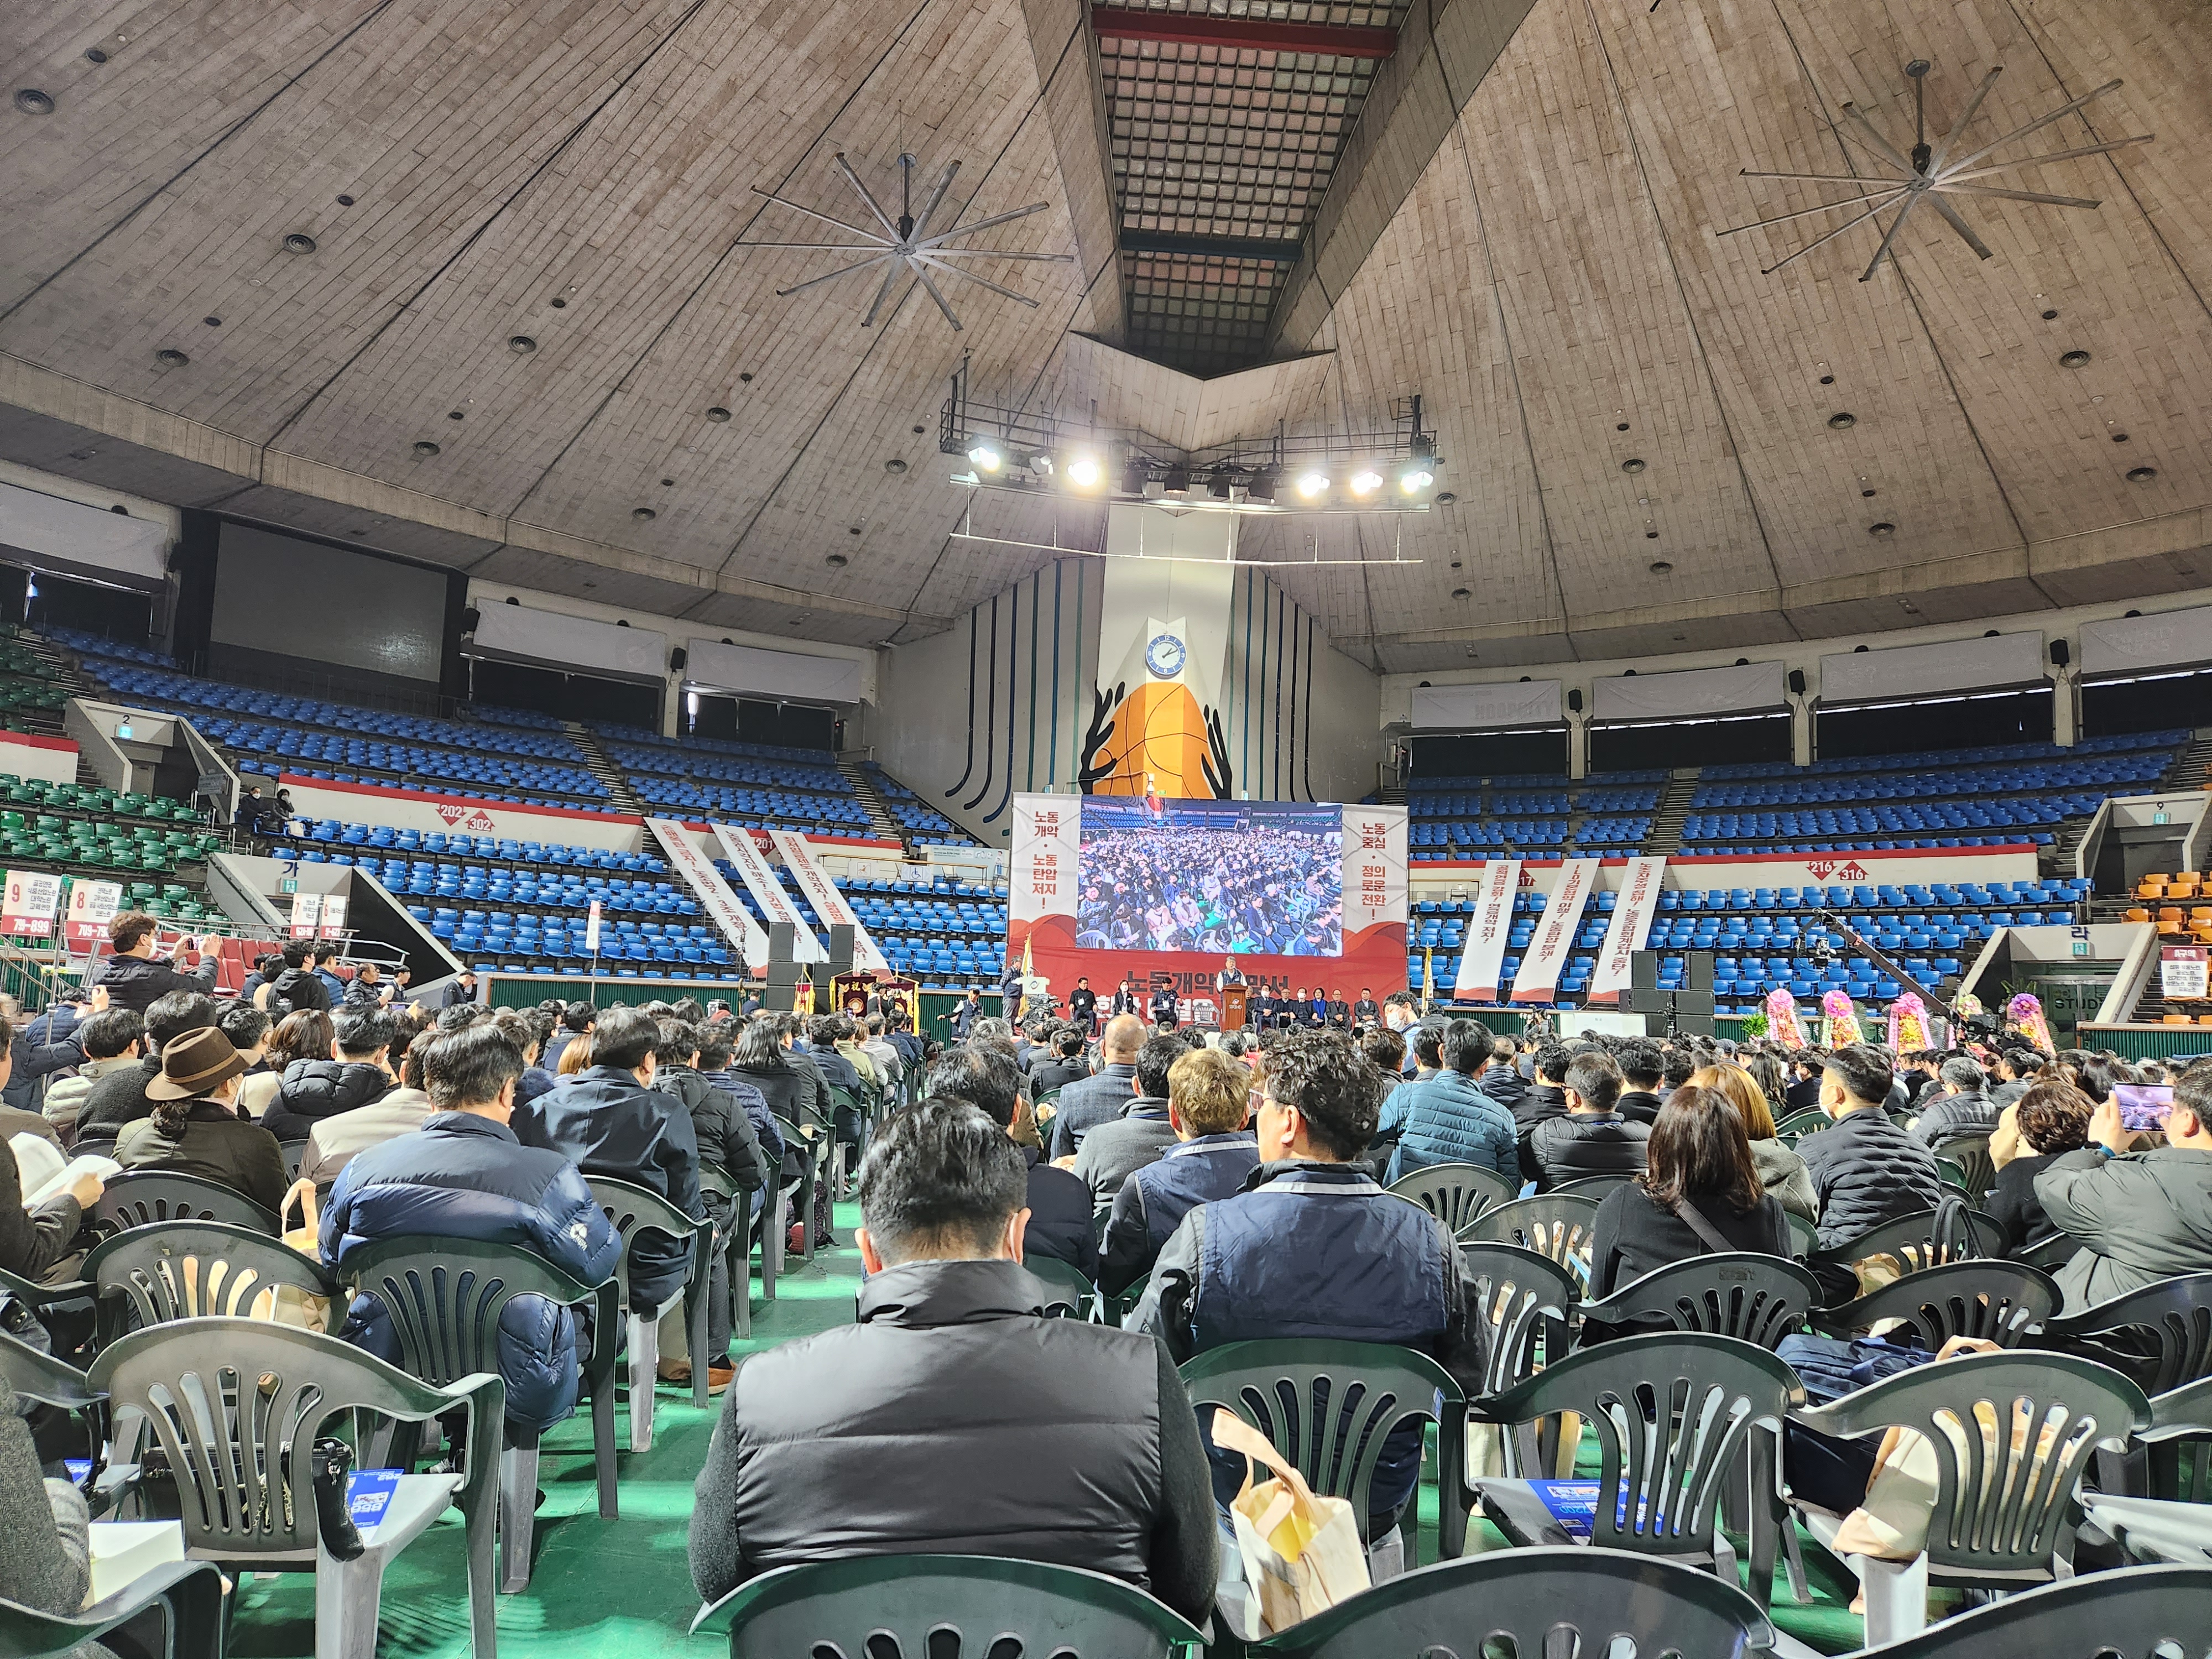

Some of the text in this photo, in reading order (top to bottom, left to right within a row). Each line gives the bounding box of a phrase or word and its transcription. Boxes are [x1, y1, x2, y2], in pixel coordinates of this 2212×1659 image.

[122, 714, 131, 724] 2
[440, 804, 463, 818] 202
[2157, 801, 2164, 810] 9
[1035, 811, 1059, 823] 노동
[469, 817, 491, 831] 302
[1362, 823, 1386, 835] 노동
[1034, 825, 1059, 838] 개악
[755, 838, 773, 849] 201
[1362, 837, 1386, 849] 중심
[1033, 854, 1057, 867] 노동
[1811, 861, 1833, 873] 216
[283, 861, 299, 877] 가
[1033, 868, 1057, 880] 탄압
[1362, 865, 1386, 878] 정의
[1634, 862, 1652, 889] 노조자주성
[1841, 869, 1864, 880] 316
[1032, 883, 1056, 895] 저지
[1361, 880, 1386, 892] 로운
[12, 884, 20, 902] 9
[1490, 886, 1506, 902] 강화!
[1630, 890, 1646, 907] 침해!
[76, 891, 85, 909] 8
[1361, 894, 1386, 906] 전환
[295, 902, 299, 915] 7
[324, 904, 328, 916] 6
[1484, 903, 1501, 925] 연금개악
[1557, 902, 1572, 919] 이행!
[1481, 926, 1496, 943] 저지!
[1545, 920, 1564, 943] 노동탄압
[2071, 926, 2090, 941] 라
[1538, 945, 1556, 962] 분쇄!
[1611, 957, 1627, 977] 중단!
[851, 981, 861, 992] 祝
[2055, 998, 2104, 1009] STUD
